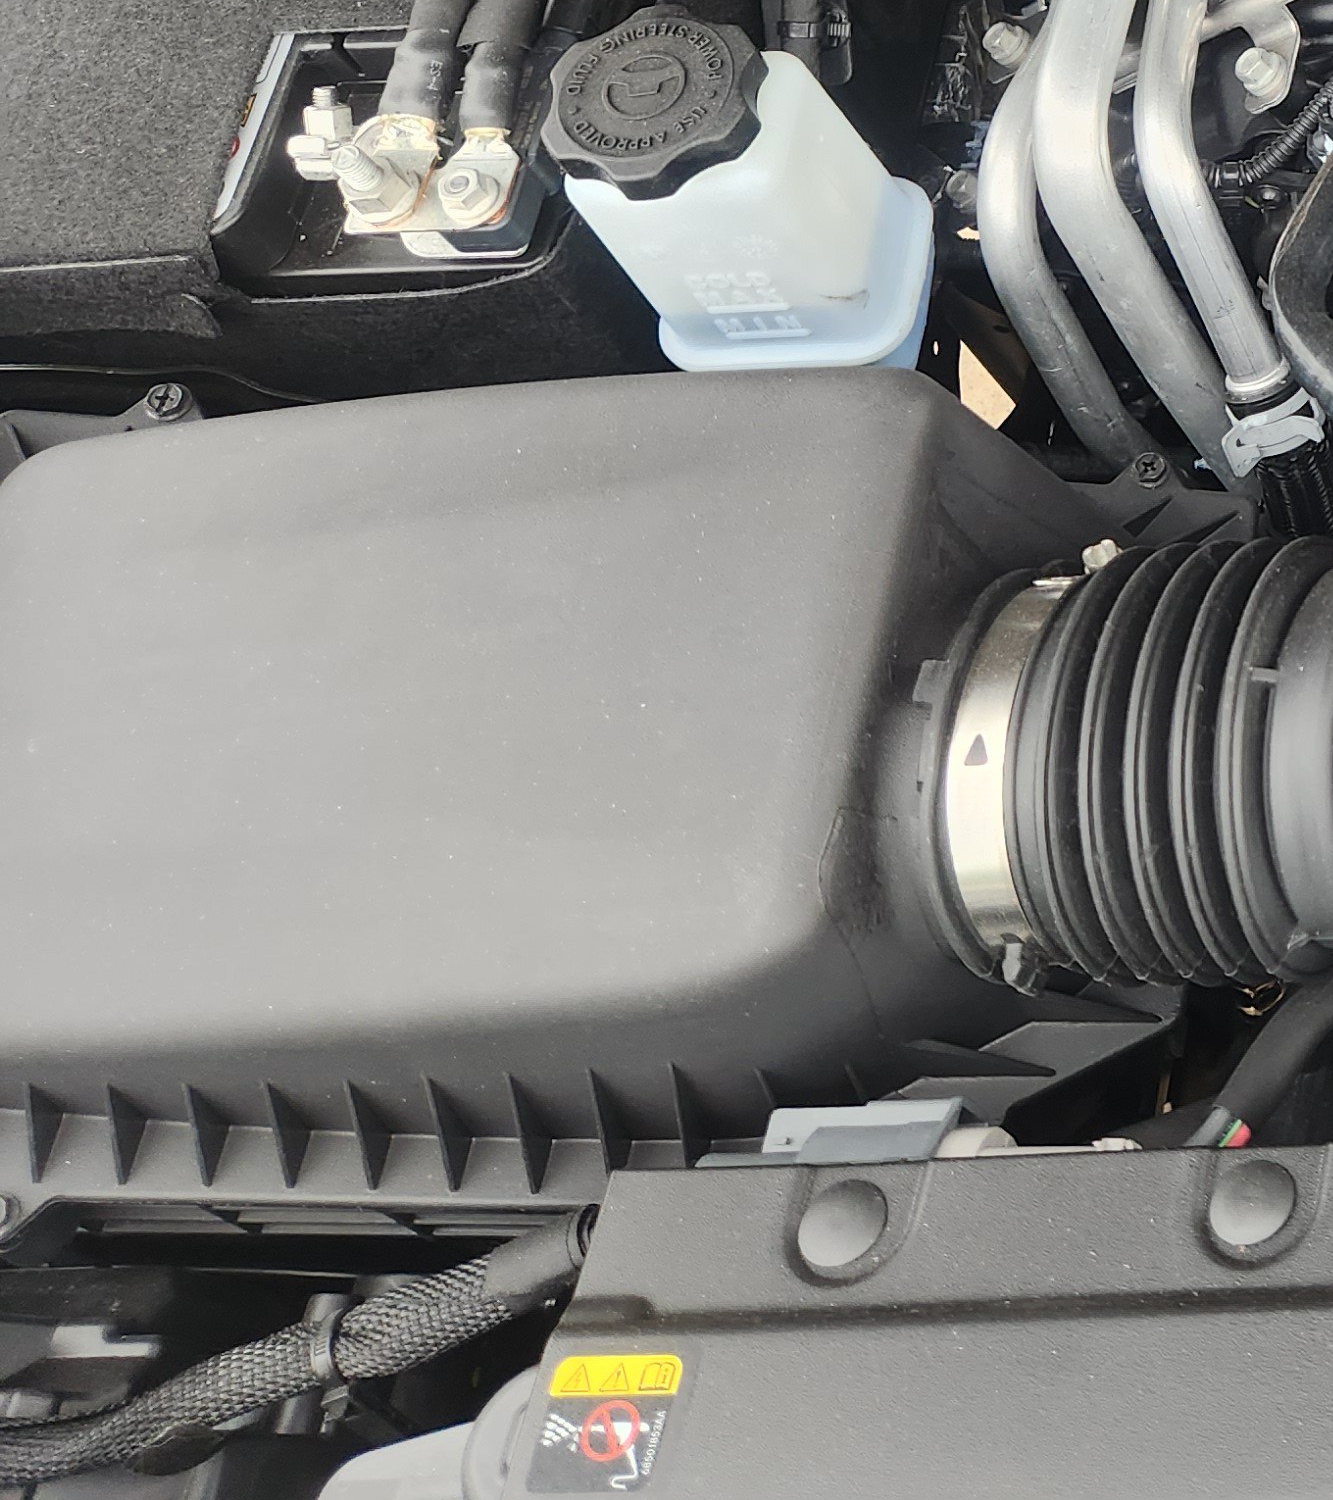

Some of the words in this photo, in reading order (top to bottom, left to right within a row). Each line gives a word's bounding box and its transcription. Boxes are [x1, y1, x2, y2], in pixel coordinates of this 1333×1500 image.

[600, 22, 690, 55] STEERING
[688, 32, 725, 81] POWER
[566, 54, 602, 96] FLUID
[673, 105, 709, 134] USE
[573, 120, 669, 151] APPROVED
[684, 270, 772, 290] COLD
[713, 314, 803, 334] MIN
